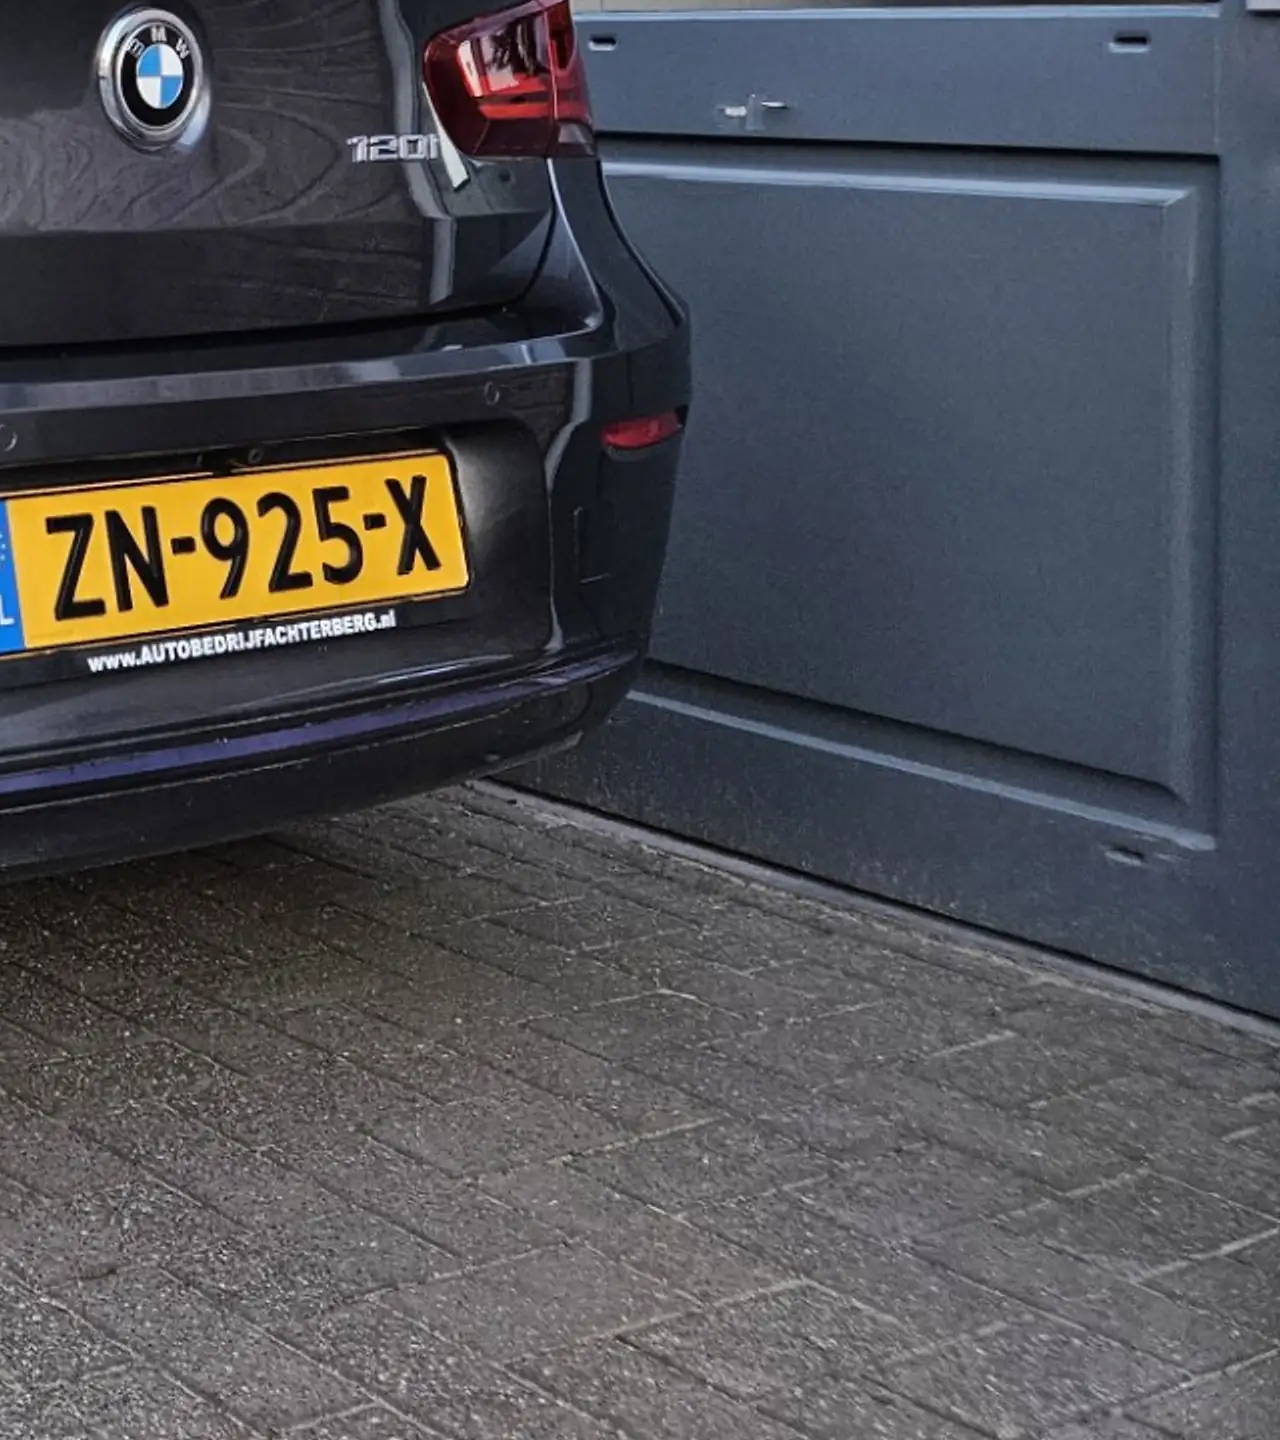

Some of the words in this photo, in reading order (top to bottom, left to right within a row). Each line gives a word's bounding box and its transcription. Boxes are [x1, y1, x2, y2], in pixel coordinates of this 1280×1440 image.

[126, 25, 191, 59] BMW
[44, 473, 442, 622] ZN-925-X
[86, 608, 398, 674] www.AUTOBEDRIJFACHTERBERG.nl
